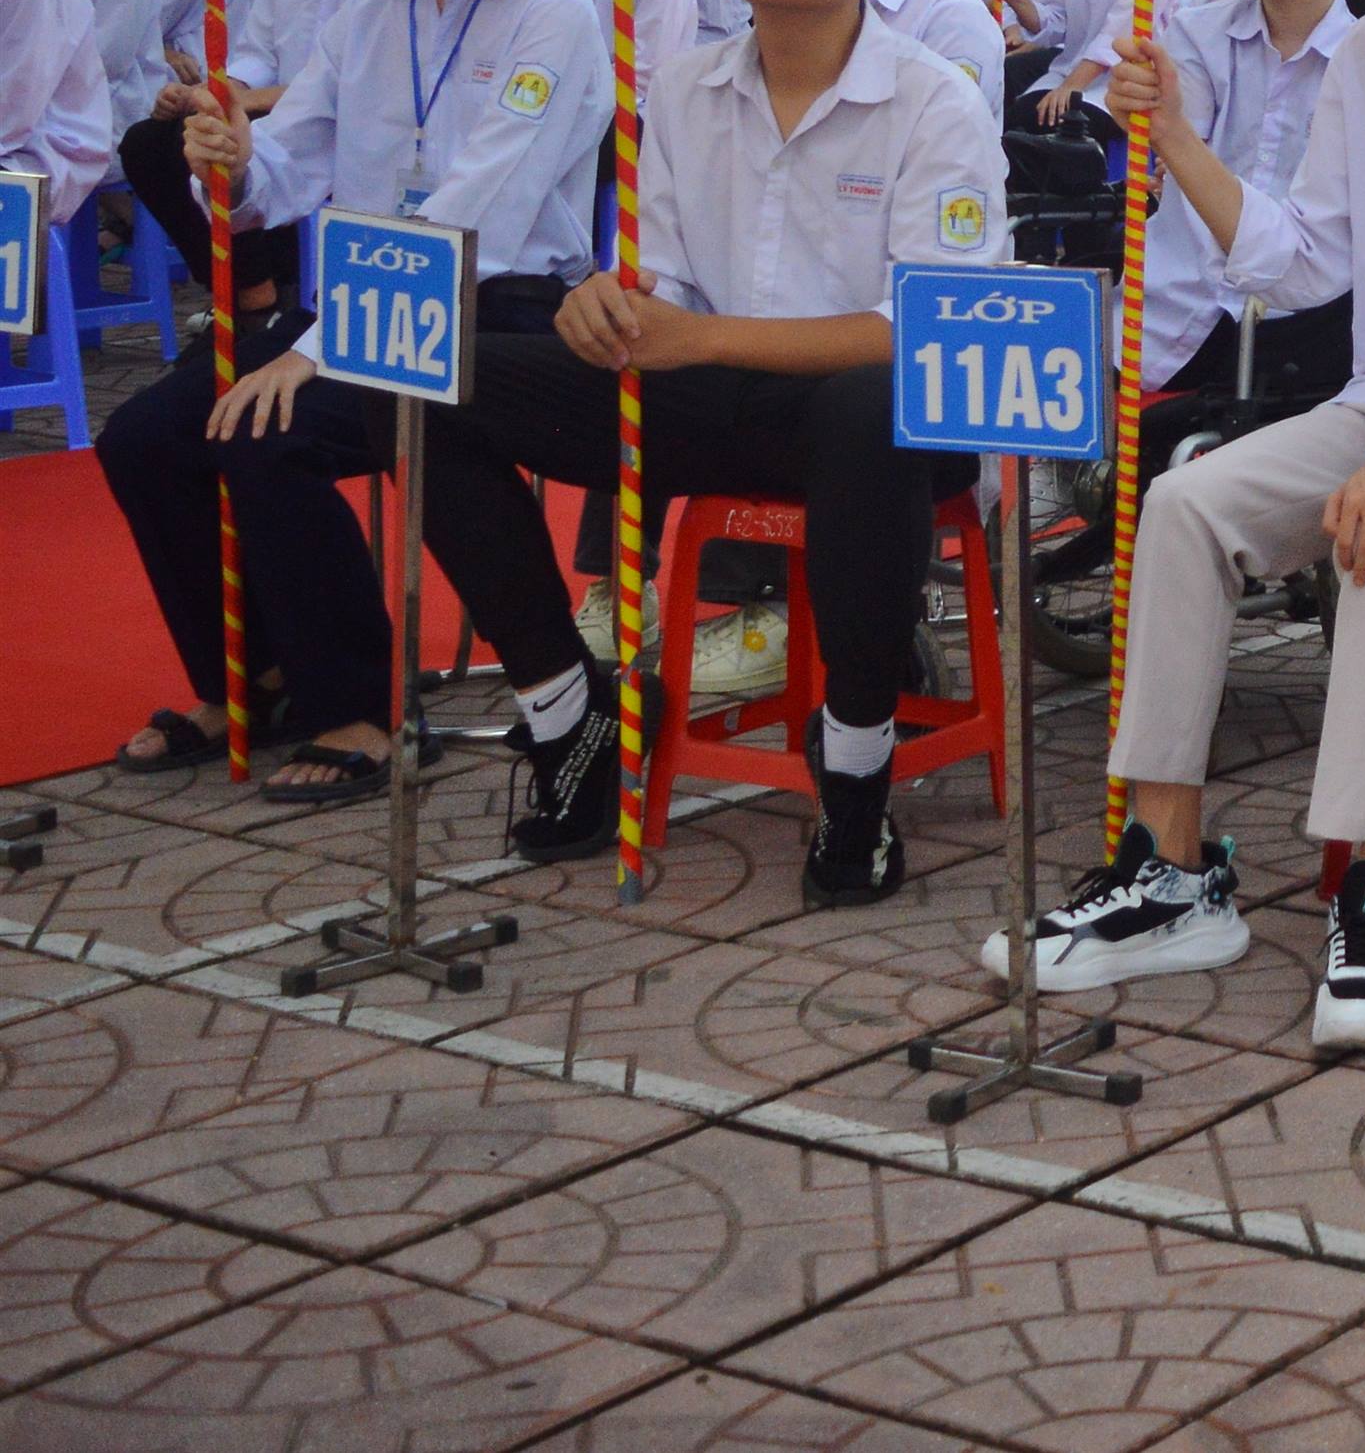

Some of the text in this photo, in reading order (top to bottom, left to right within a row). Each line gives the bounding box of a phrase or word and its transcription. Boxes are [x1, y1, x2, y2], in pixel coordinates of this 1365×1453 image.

[348, 242, 430, 275] LỚP
[331, 284, 447, 377] 11A2
[937, 291, 1056, 324] LỚP
[915, 342, 1084, 432] 11A3
